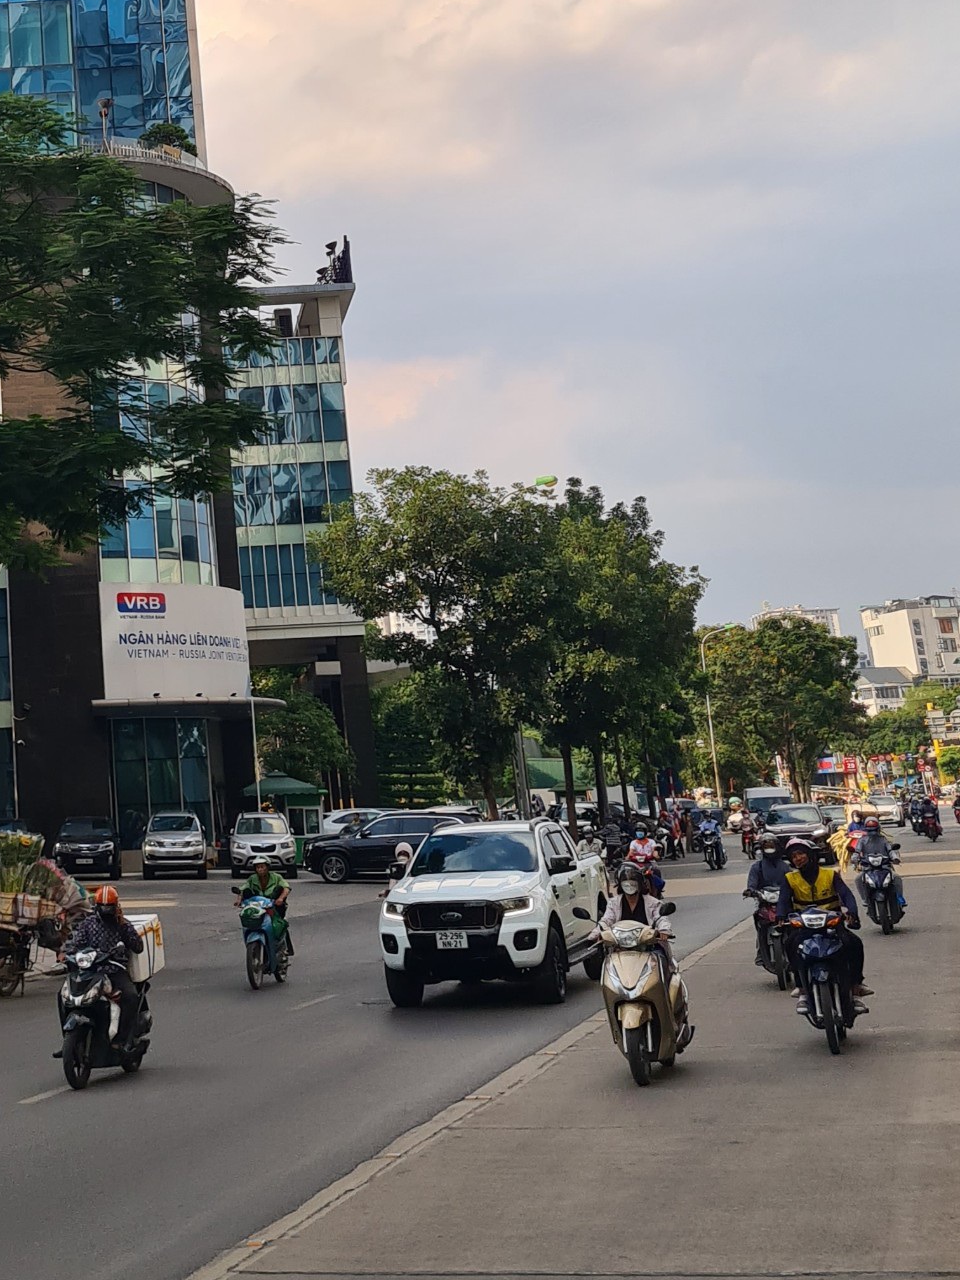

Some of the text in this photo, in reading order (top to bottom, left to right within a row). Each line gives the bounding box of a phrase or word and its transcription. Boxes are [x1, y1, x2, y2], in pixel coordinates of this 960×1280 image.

[123, 596, 161, 610] VRB
[118, 631, 154, 645] NGÂN
[156, 631, 188, 646] HÀNG
[189, 632, 208, 646] LIÊN
[209, 635, 231, 648] DOANH
[127, 649, 169, 659] VIETNAM
[179, 649, 207, 660] RUSSIA
[208, 650, 225, 660] JOINT
